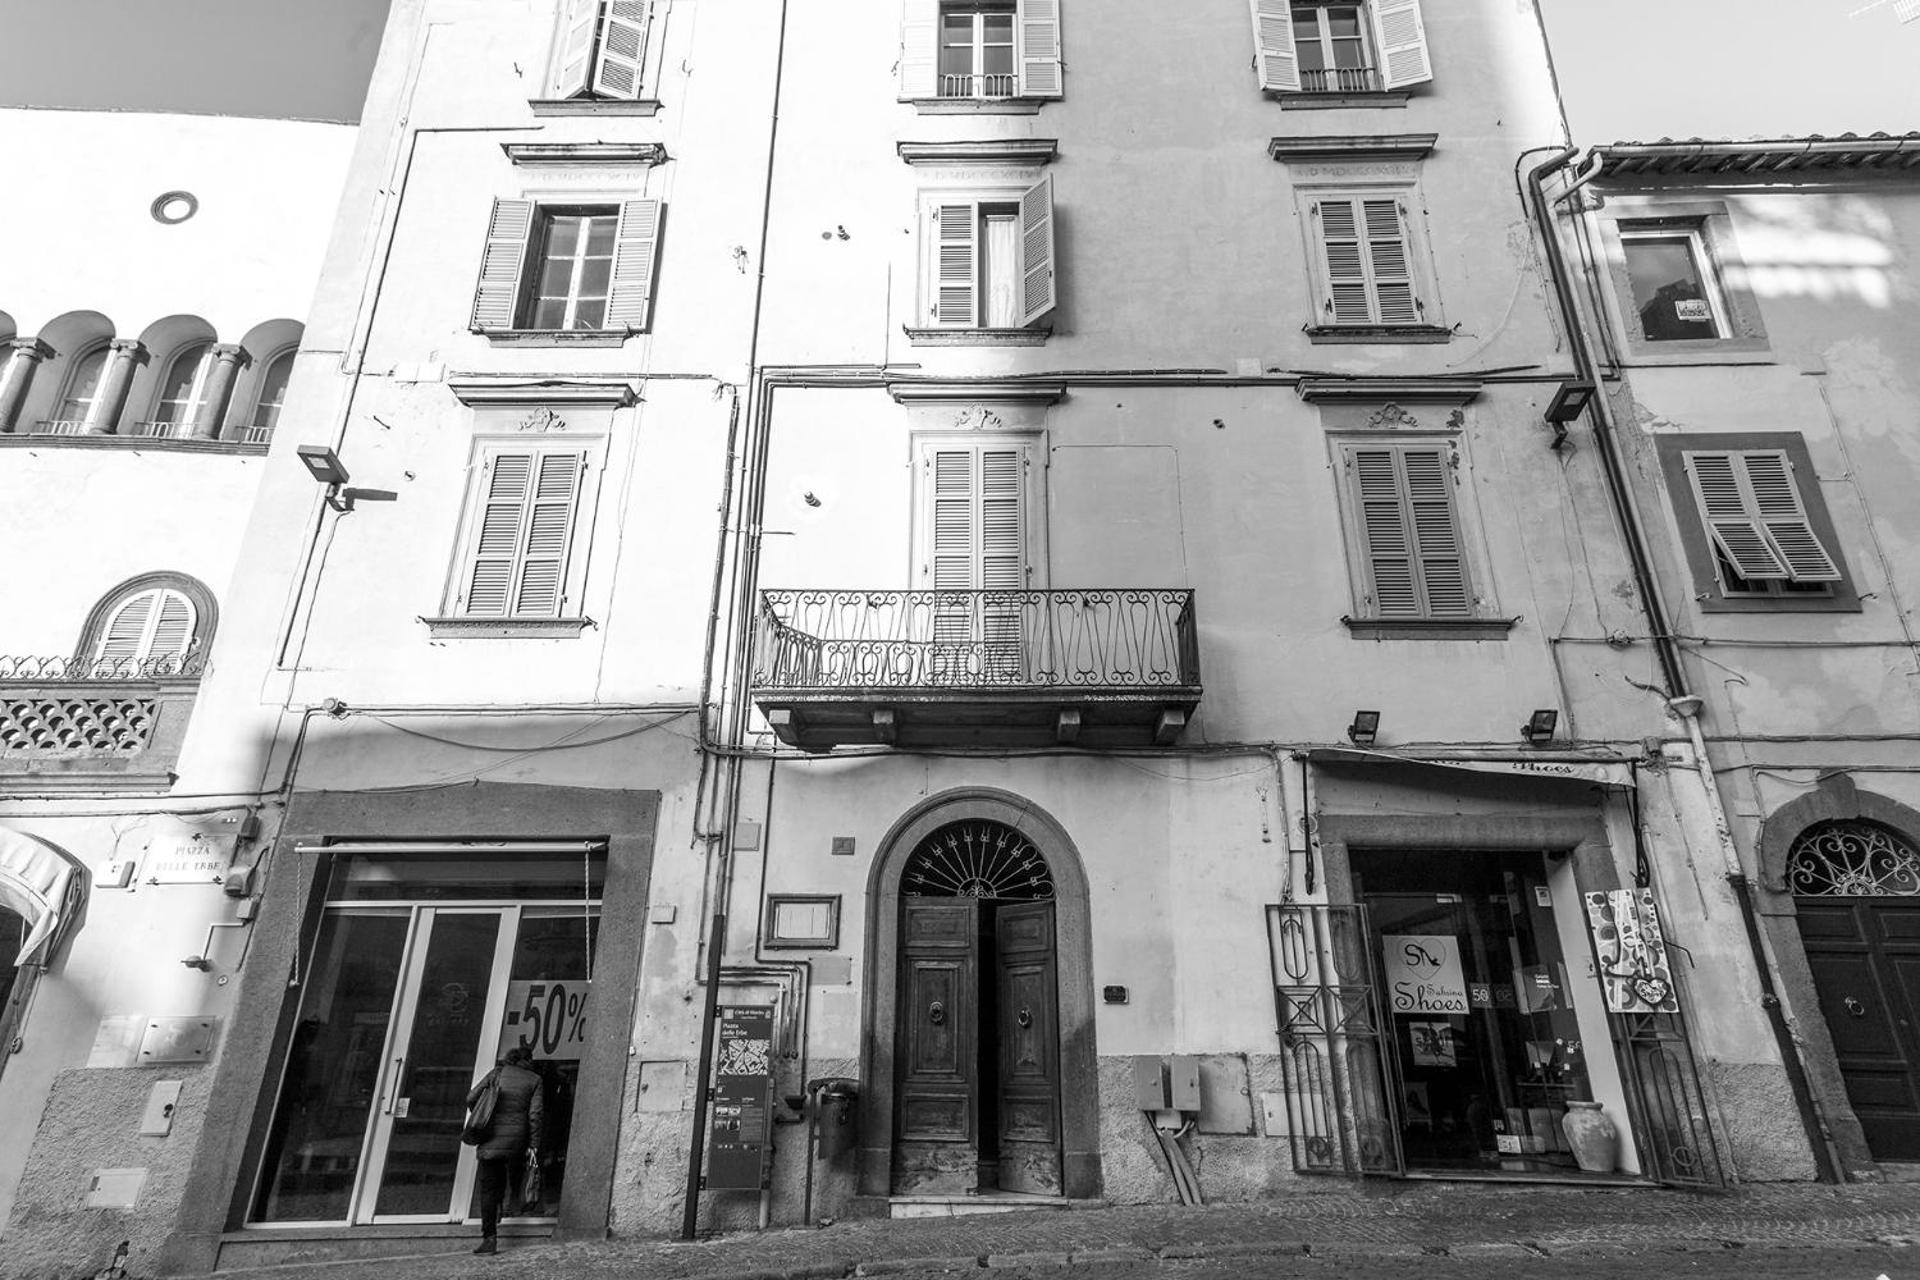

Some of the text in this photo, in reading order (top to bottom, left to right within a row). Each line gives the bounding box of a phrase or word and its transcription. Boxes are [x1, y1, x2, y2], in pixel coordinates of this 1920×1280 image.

[175, 846, 210, 856] PIAZZA
[194, 862, 221, 871] ERBE
[1394, 981, 1467, 1011] Shoes
